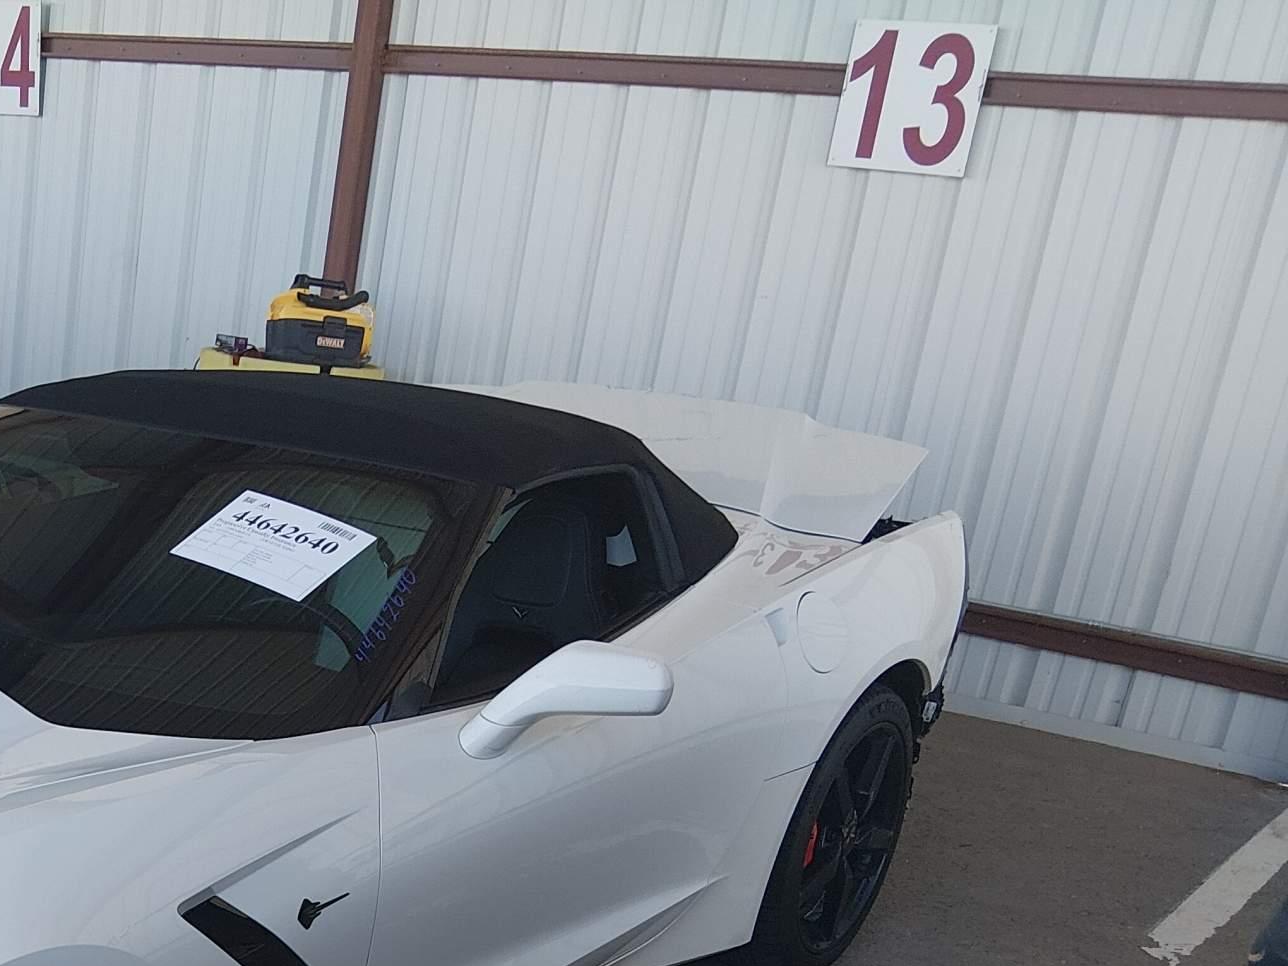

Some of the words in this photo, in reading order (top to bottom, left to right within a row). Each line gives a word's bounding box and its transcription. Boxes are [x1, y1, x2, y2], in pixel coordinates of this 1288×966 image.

[849, 29, 976, 166] 13
[231, 510, 339, 555] 44642640
[355, 568, 416, 663] 44642640
